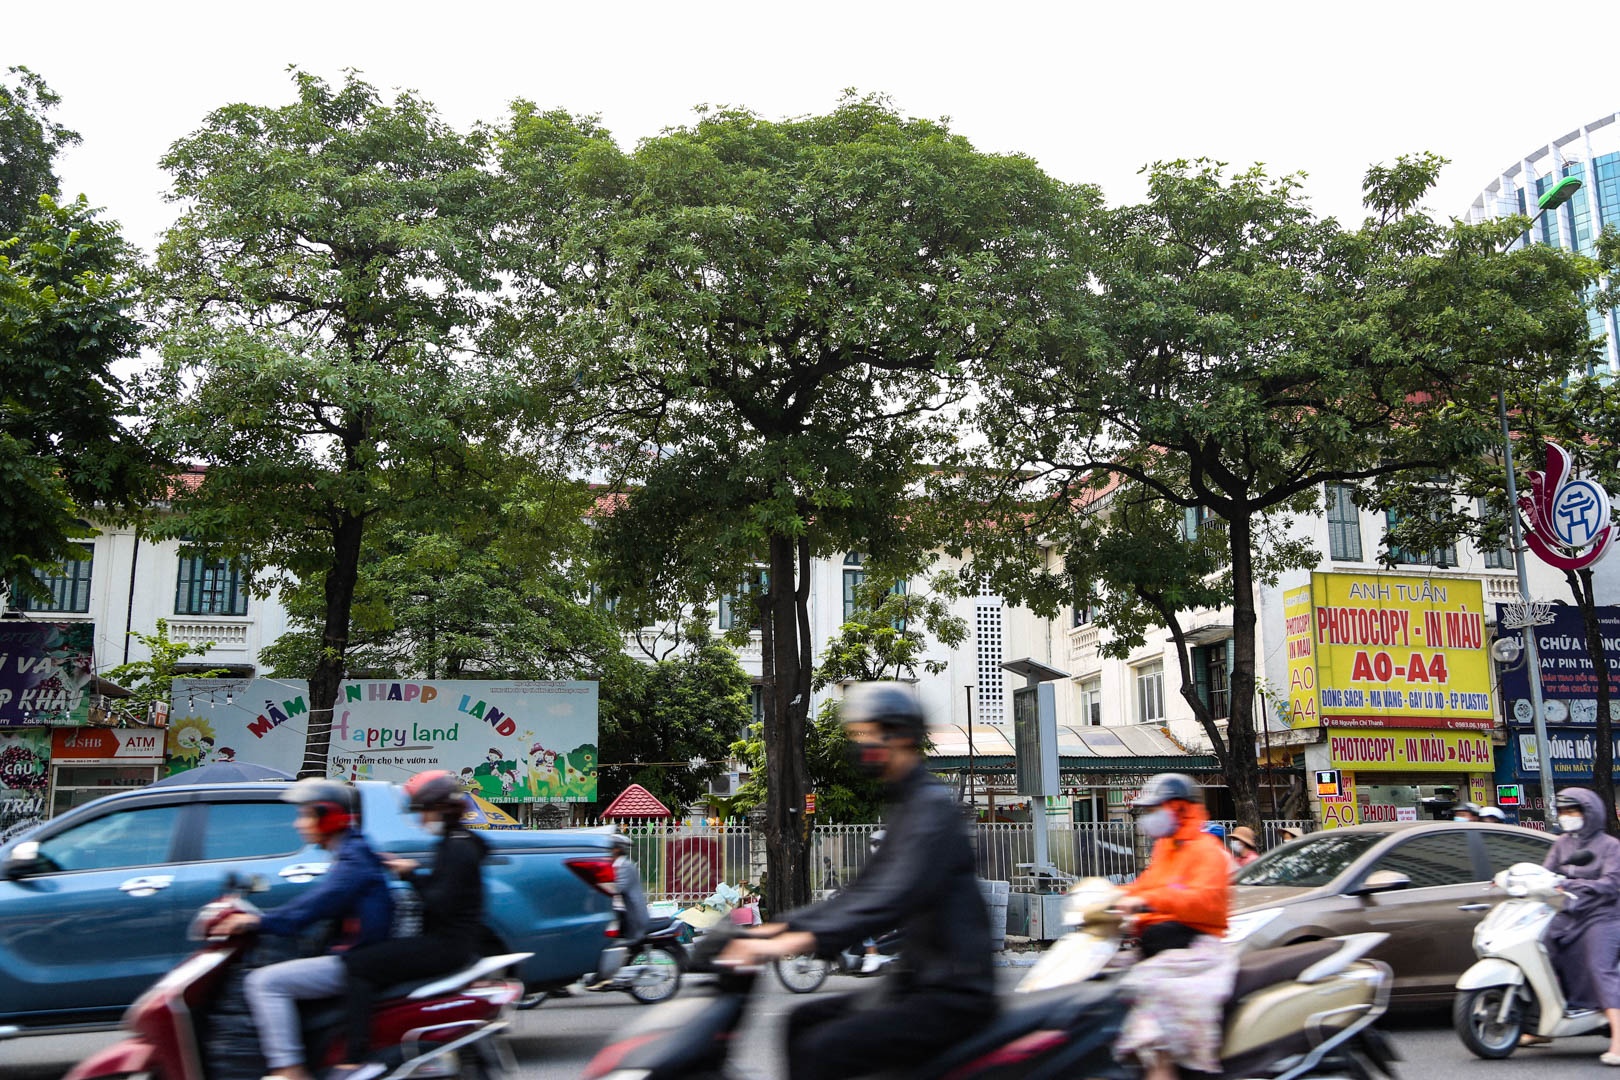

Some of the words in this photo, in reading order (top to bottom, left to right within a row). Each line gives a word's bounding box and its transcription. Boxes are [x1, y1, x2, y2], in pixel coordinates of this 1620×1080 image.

[1350, 582, 1390, 600] ANH
[1396, 579, 1447, 602] TUẤN
[1286, 613, 1310, 636] PHOTOCOPY
[1317, 607, 1409, 646] PHOTOCOPY
[1425, 611, 1442, 647] IN
[1446, 605, 1482, 649] MÀU
[1289, 641, 1297, 659] IN
[1297, 636, 1311, 657] MÀU
[1540, 634, 1581, 650] CHỮA
[1558, 658, 1577, 668] PIN
[1344, 688, 1364, 707] SÁCH
[1370, 690, 1382, 711] MẠ
[1383, 688, 1403, 708] VÀNG
[1460, 693, 1489, 711] PLASTIC
[368, 684, 438, 704] HAPP
[458, 694, 516, 737] LAND
[1292, 697, 1316, 722] A4
[413, 722, 459, 741] land
[1340, 718, 1359, 727] Nguyễn
[77, 738, 102, 748] SHB
[126, 737, 155, 748] ATM
[1331, 737, 1395, 762] PHOTOCOPY
[1405, 738, 1419, 762] IN
[1420, 732, 1446, 763] MÀU
[377, 756, 392, 765] cho
[1471, 778, 1484, 787] PHO
[1475, 792, 1483, 801] TO
[1363, 805, 1396, 821] PHOTO
